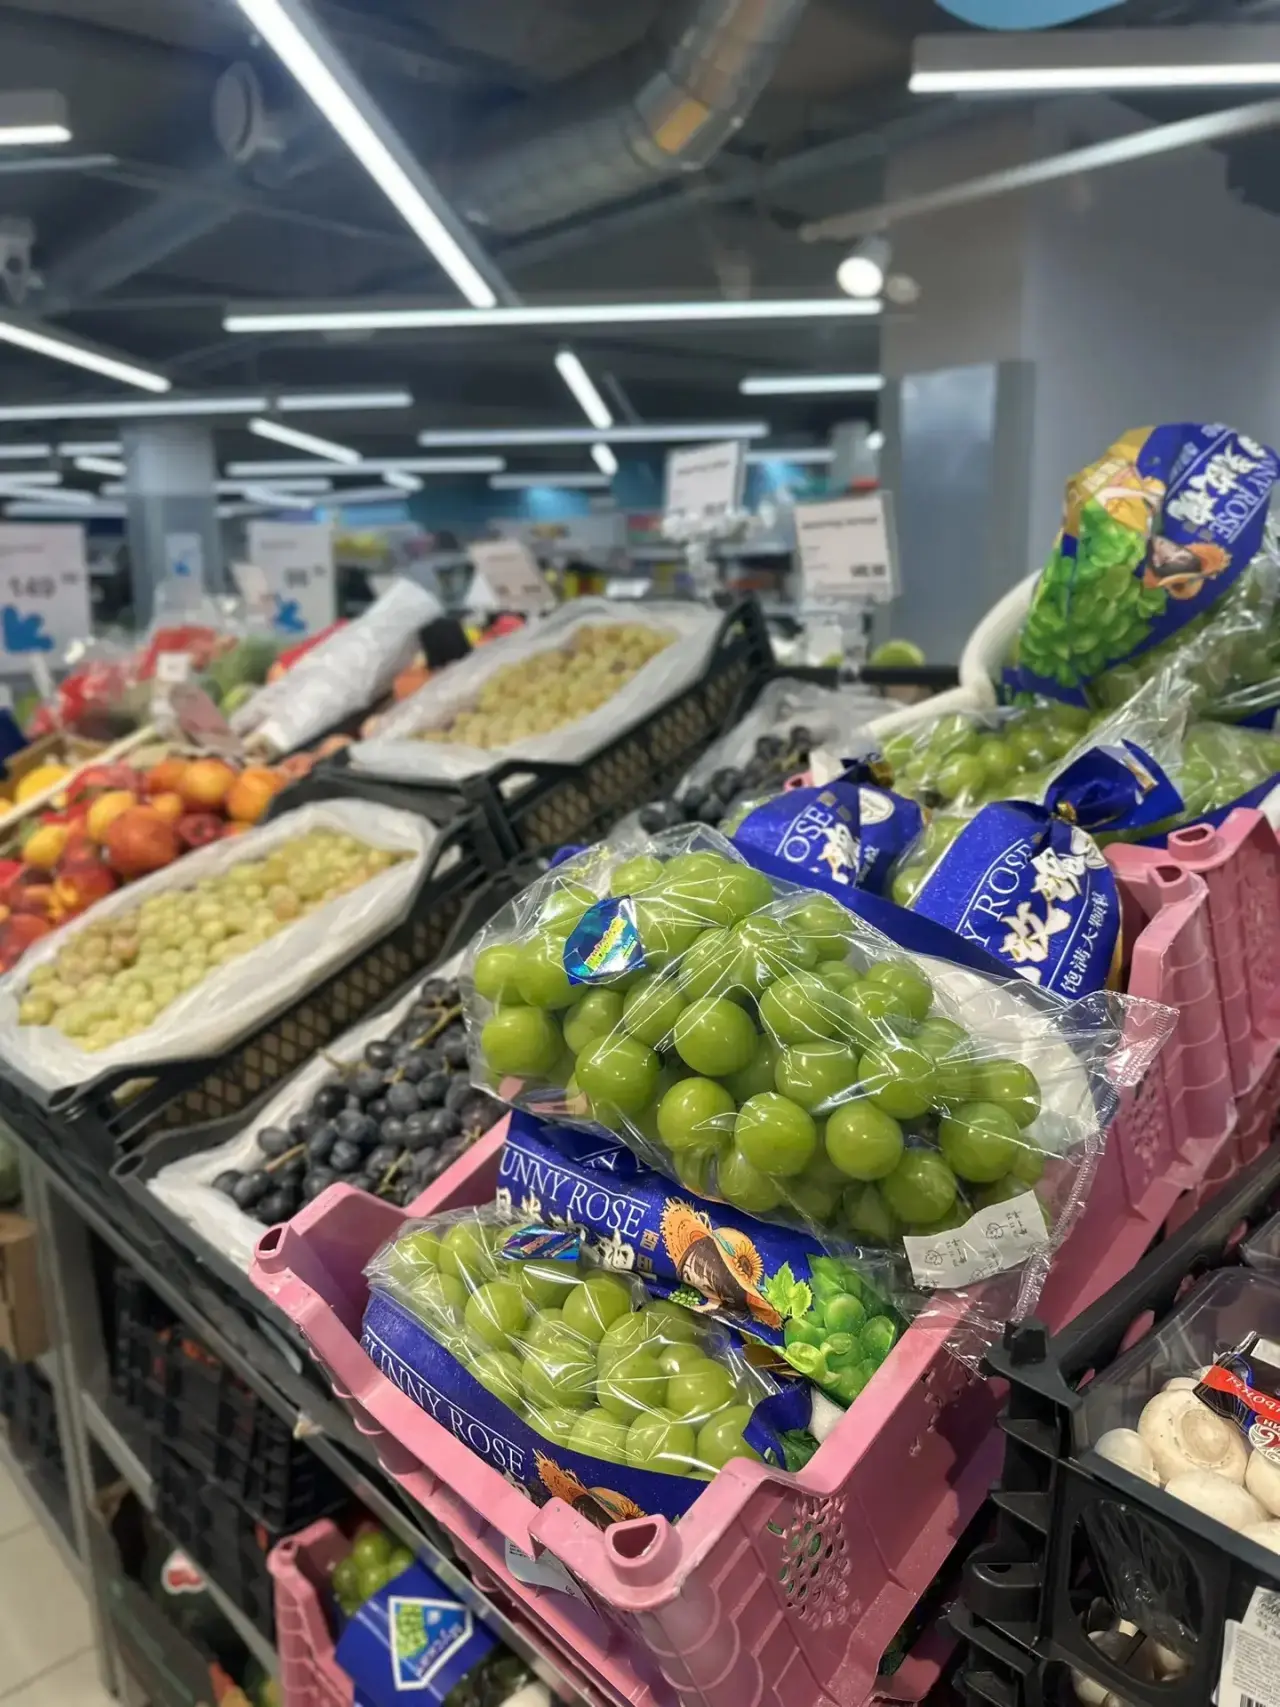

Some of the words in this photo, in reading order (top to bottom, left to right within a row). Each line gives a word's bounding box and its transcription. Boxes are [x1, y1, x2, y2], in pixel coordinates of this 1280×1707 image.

[1207, 482, 1259, 539] ROSE
[500, 1147, 570, 1201] UNNY
[567, 1181, 644, 1239] ROSE
[448, 1406, 525, 1480] ROSE
